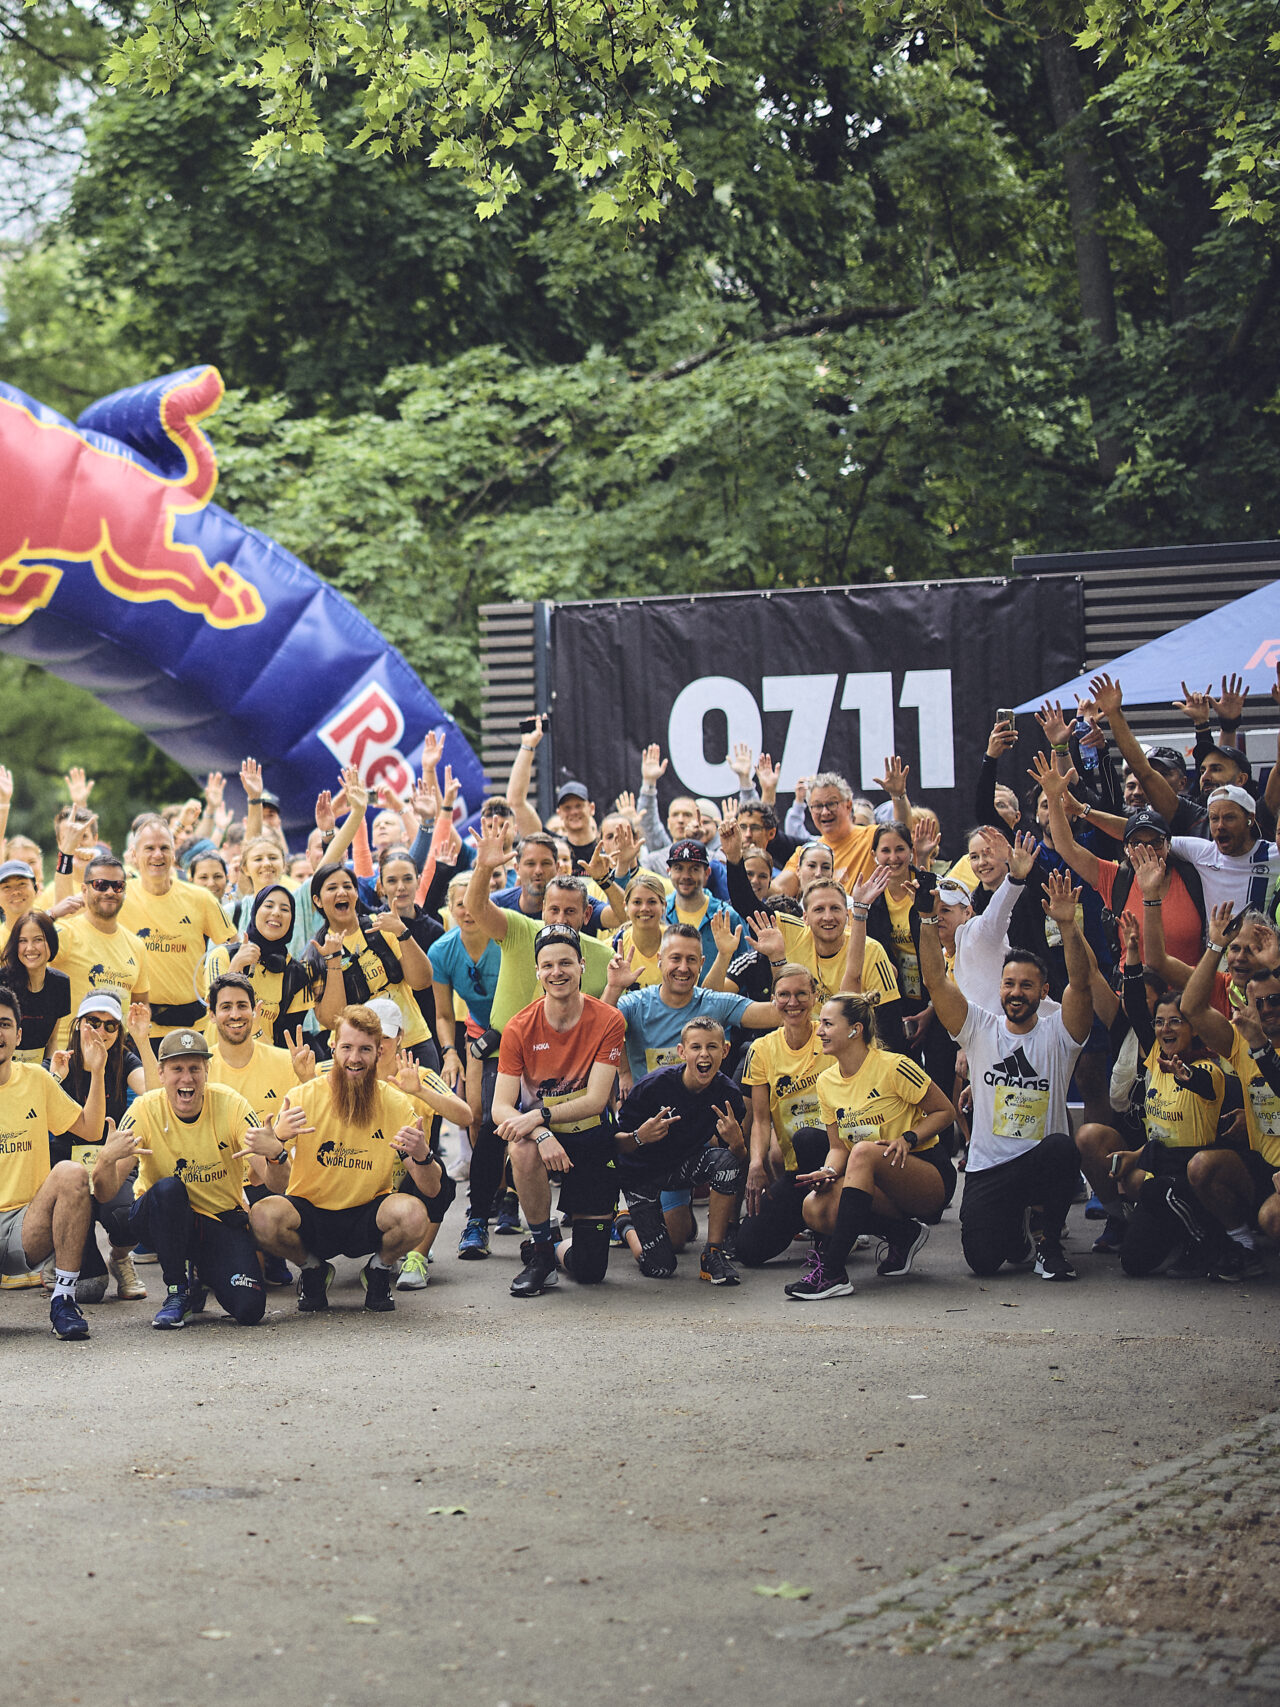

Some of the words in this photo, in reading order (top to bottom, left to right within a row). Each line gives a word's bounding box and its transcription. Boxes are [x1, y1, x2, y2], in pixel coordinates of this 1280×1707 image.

[668, 669, 955, 798] 0711
[325, 688, 410, 801] Re
[533, 1042, 550, 1051] HOKA
[983, 1071, 1050, 1092] adidas
[1004, 1112, 1036, 1123] 147786
[326, 1155, 373, 1170] WORLDRUN
